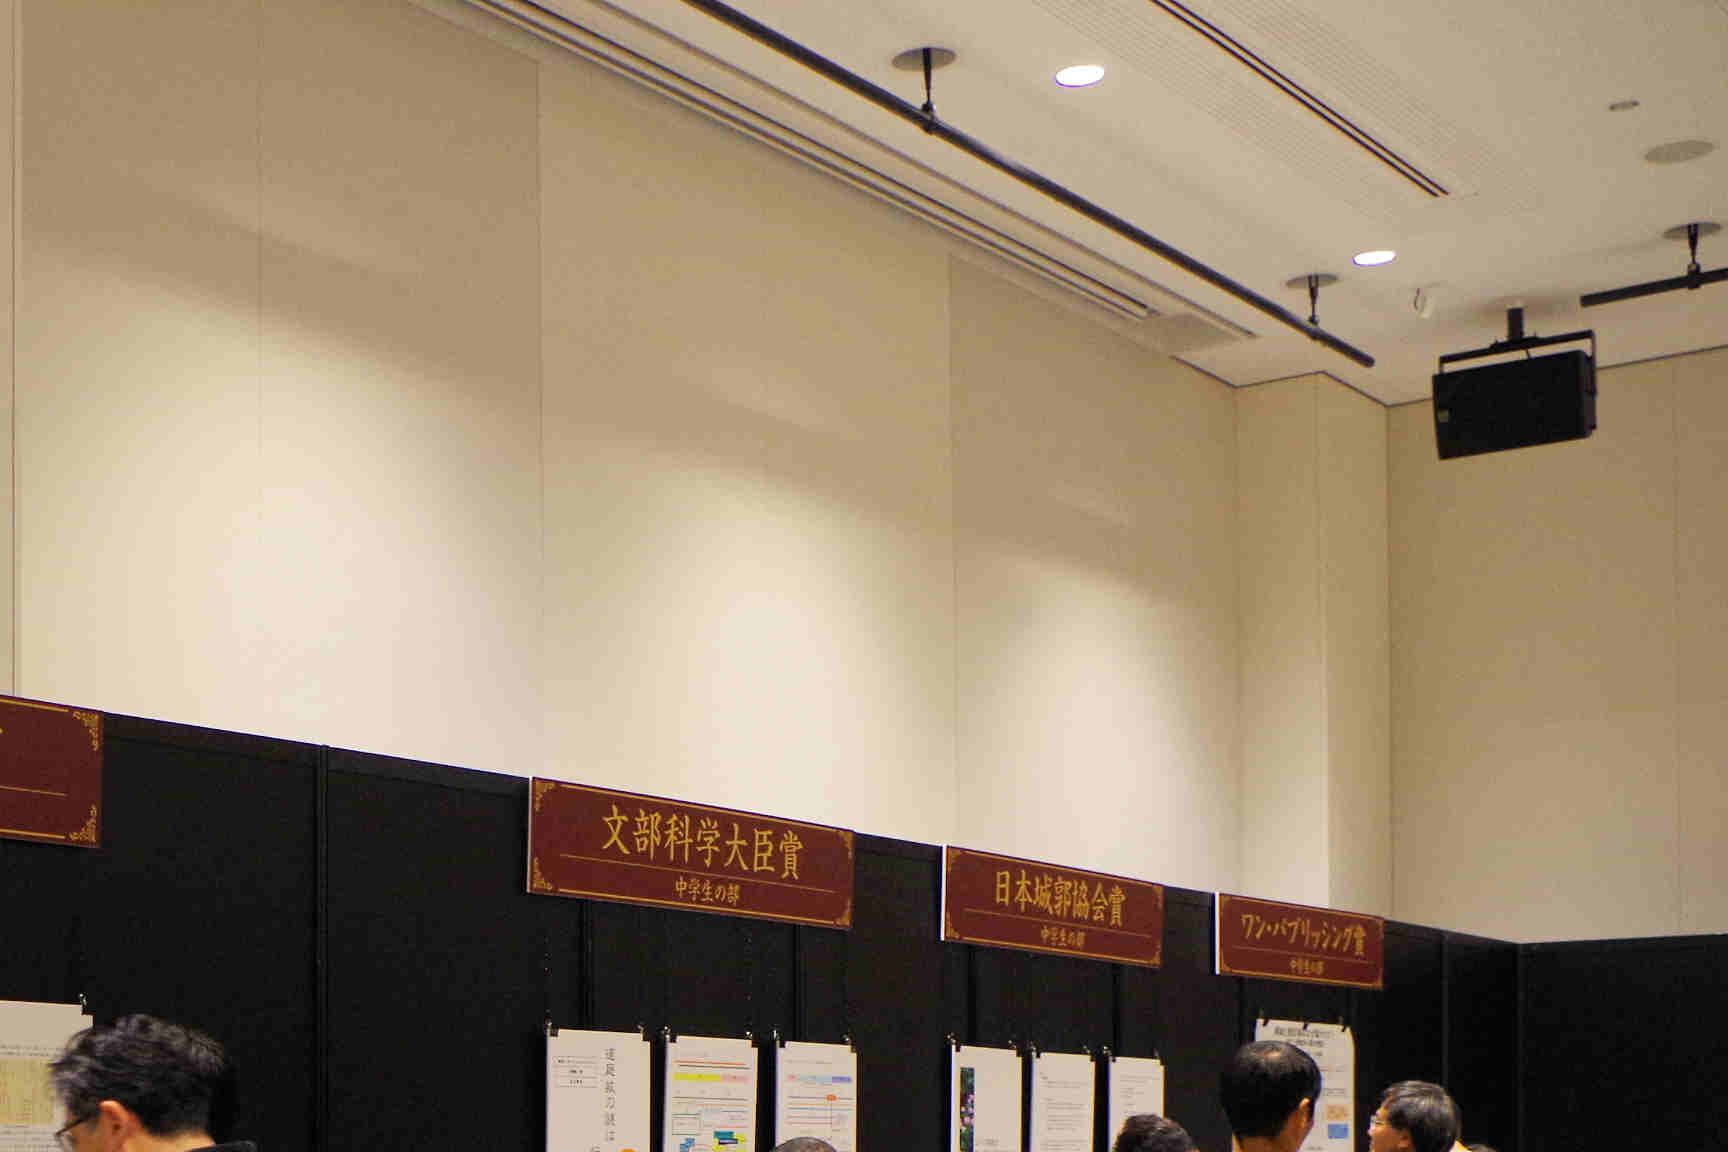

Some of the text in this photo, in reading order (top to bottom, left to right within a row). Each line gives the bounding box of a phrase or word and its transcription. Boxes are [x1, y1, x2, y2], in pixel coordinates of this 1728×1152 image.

[602, 804, 803, 880] 文部科学大臣賞
[675, 876, 740, 905] 中学生の部
[996, 869, 1126, 927] 日本城郭協会賞
